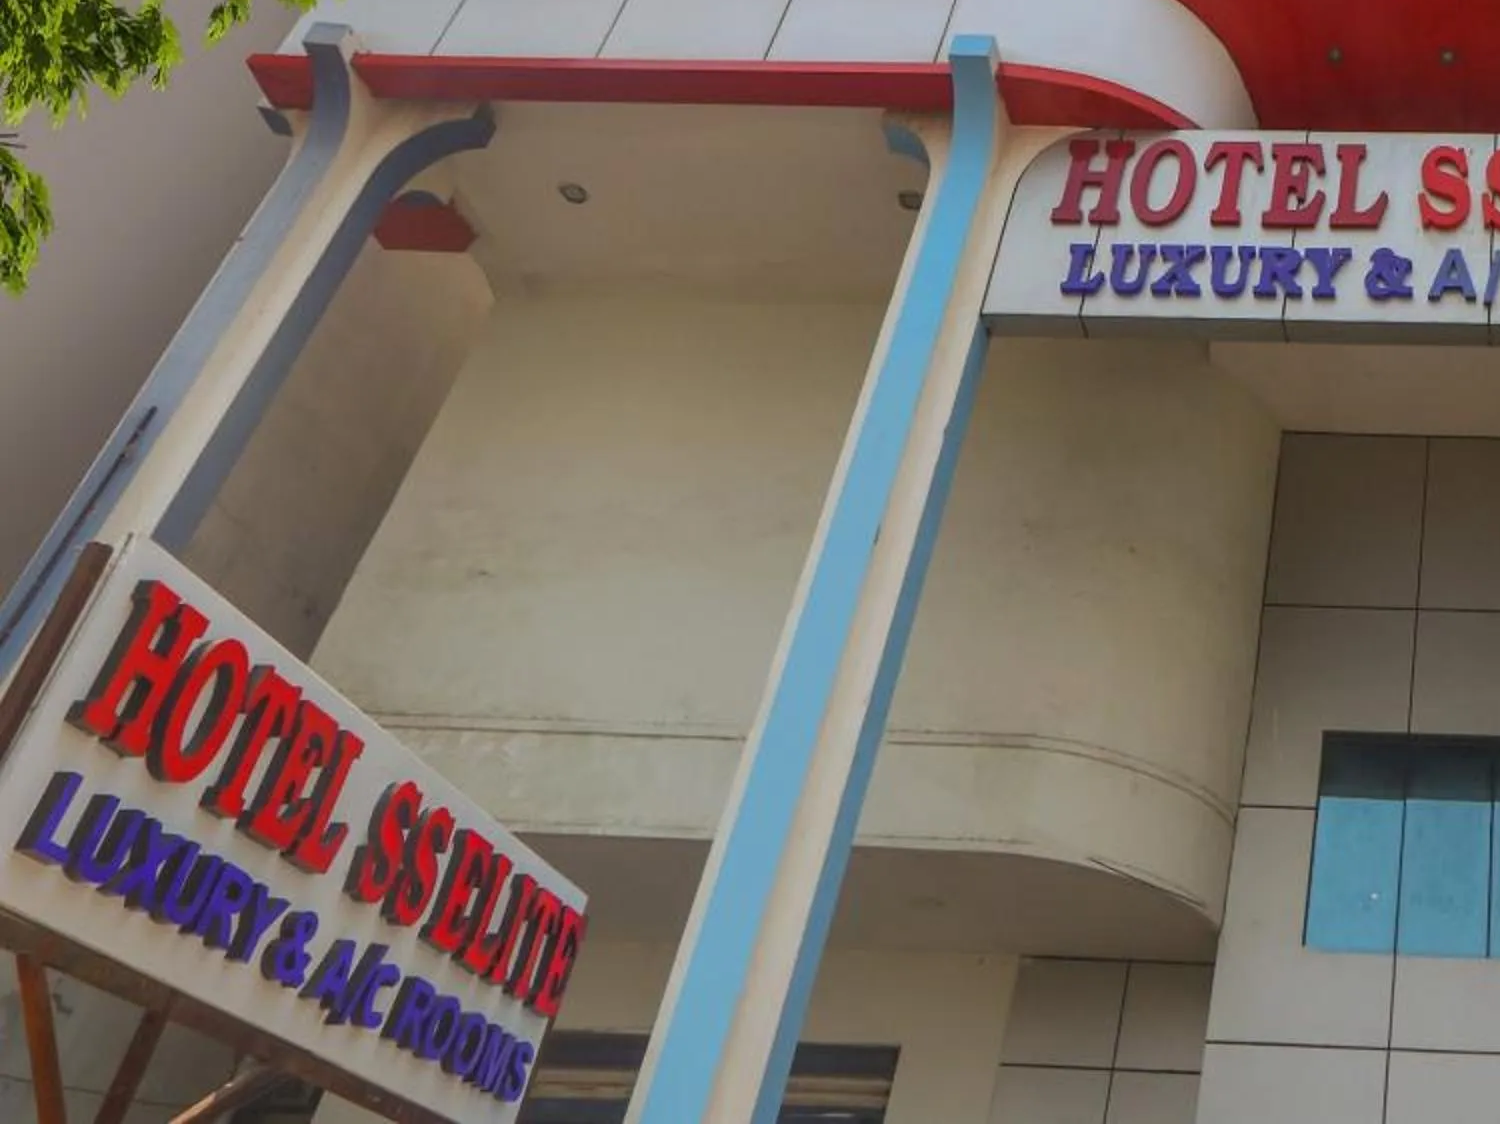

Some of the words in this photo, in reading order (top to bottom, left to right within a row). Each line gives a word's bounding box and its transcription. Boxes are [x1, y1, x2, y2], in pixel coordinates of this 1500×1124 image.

[1051, 139, 1389, 232] HOTEL
[1060, 244, 1353, 301] LUXURY
[1364, 250, 1414, 303] &
[64, 579, 364, 874] HOTEL
[15, 771, 290, 963] LUXURY
[261, 911, 318, 988] &
[298, 939, 401, 1028] A/C
[379, 975, 534, 1102] ROOMS
